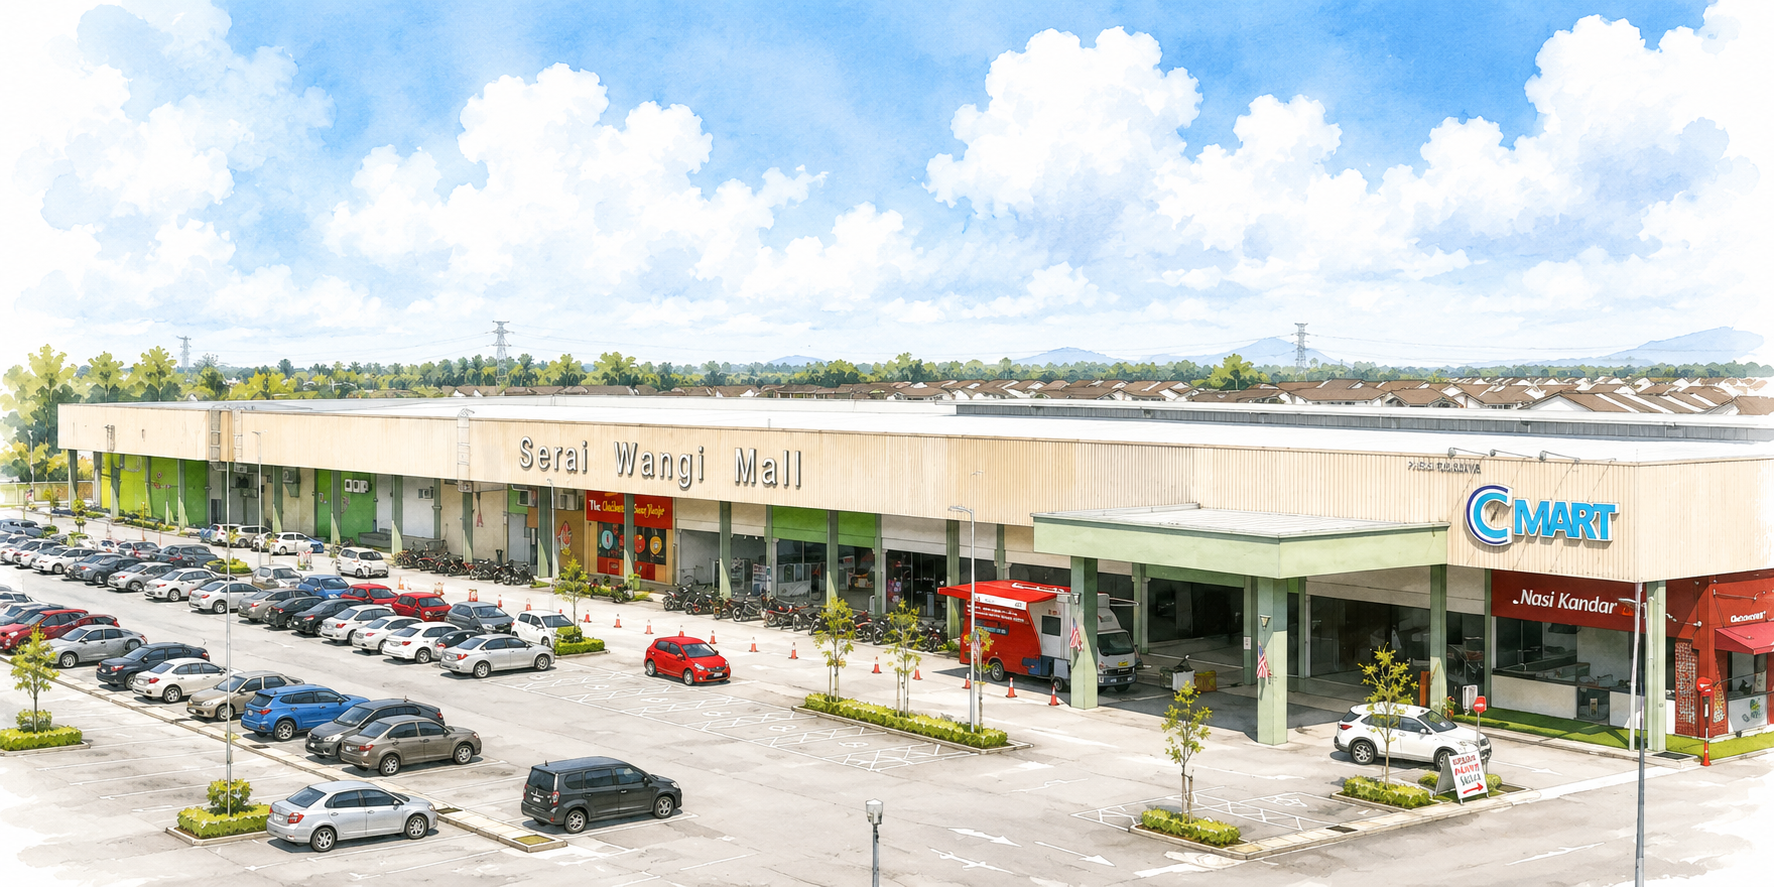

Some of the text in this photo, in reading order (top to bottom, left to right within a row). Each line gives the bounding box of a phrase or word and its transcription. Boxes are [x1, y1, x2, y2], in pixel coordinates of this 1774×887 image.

[519, 436, 802, 490] Serai Wangi Mall
[589, 500, 601, 511] The
[1520, 589, 1617, 614] Nasi Kandar
